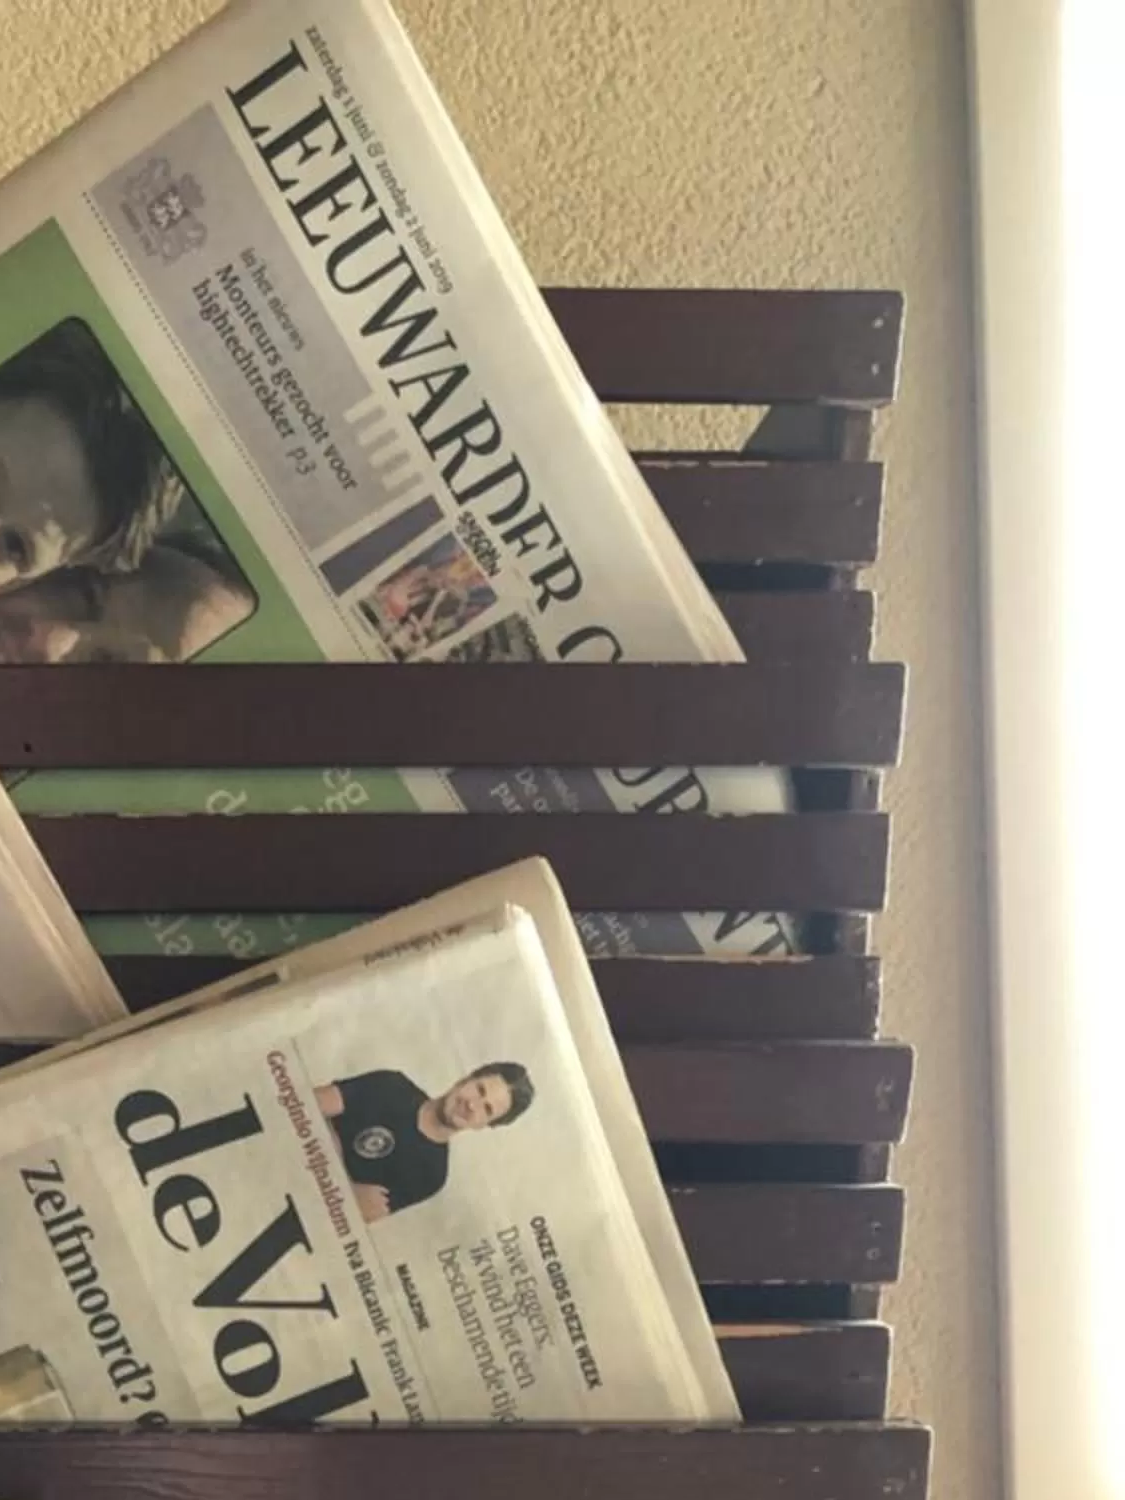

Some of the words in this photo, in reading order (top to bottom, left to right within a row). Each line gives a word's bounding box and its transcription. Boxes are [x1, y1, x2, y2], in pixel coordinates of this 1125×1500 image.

[368, 156, 418, 219] zondag
[184, 277, 305, 441] hightechtrekker
[210, 262, 290, 368] Monteurs
[270, 364, 335, 446] gezocht
[319, 442, 360, 493] voor
[224, 38, 589, 610] LEEUWARDER
[18, 1157, 158, 1409] Zelfmoord?
[116, 1086, 382, 1425] deVol
[262, 1047, 317, 1141] Georginio
[299, 1137, 356, 1239] Wijnaldum
[340, 1239, 367, 1271] Iva
[378, 1337, 415, 1393] Frank
[476, 1261, 514, 1313] vind
[494, 1224, 531, 1278] Dave
[528, 1213, 557, 1261] ONZE
[544, 1258, 572, 1302] GIDS
[559, 1299, 587, 1346] DEZE
[574, 1343, 603, 1391] WEEK
[435, 1244, 510, 1392] beschamende
[493, 1310, 527, 1350] het
[506, 1347, 538, 1390] een
